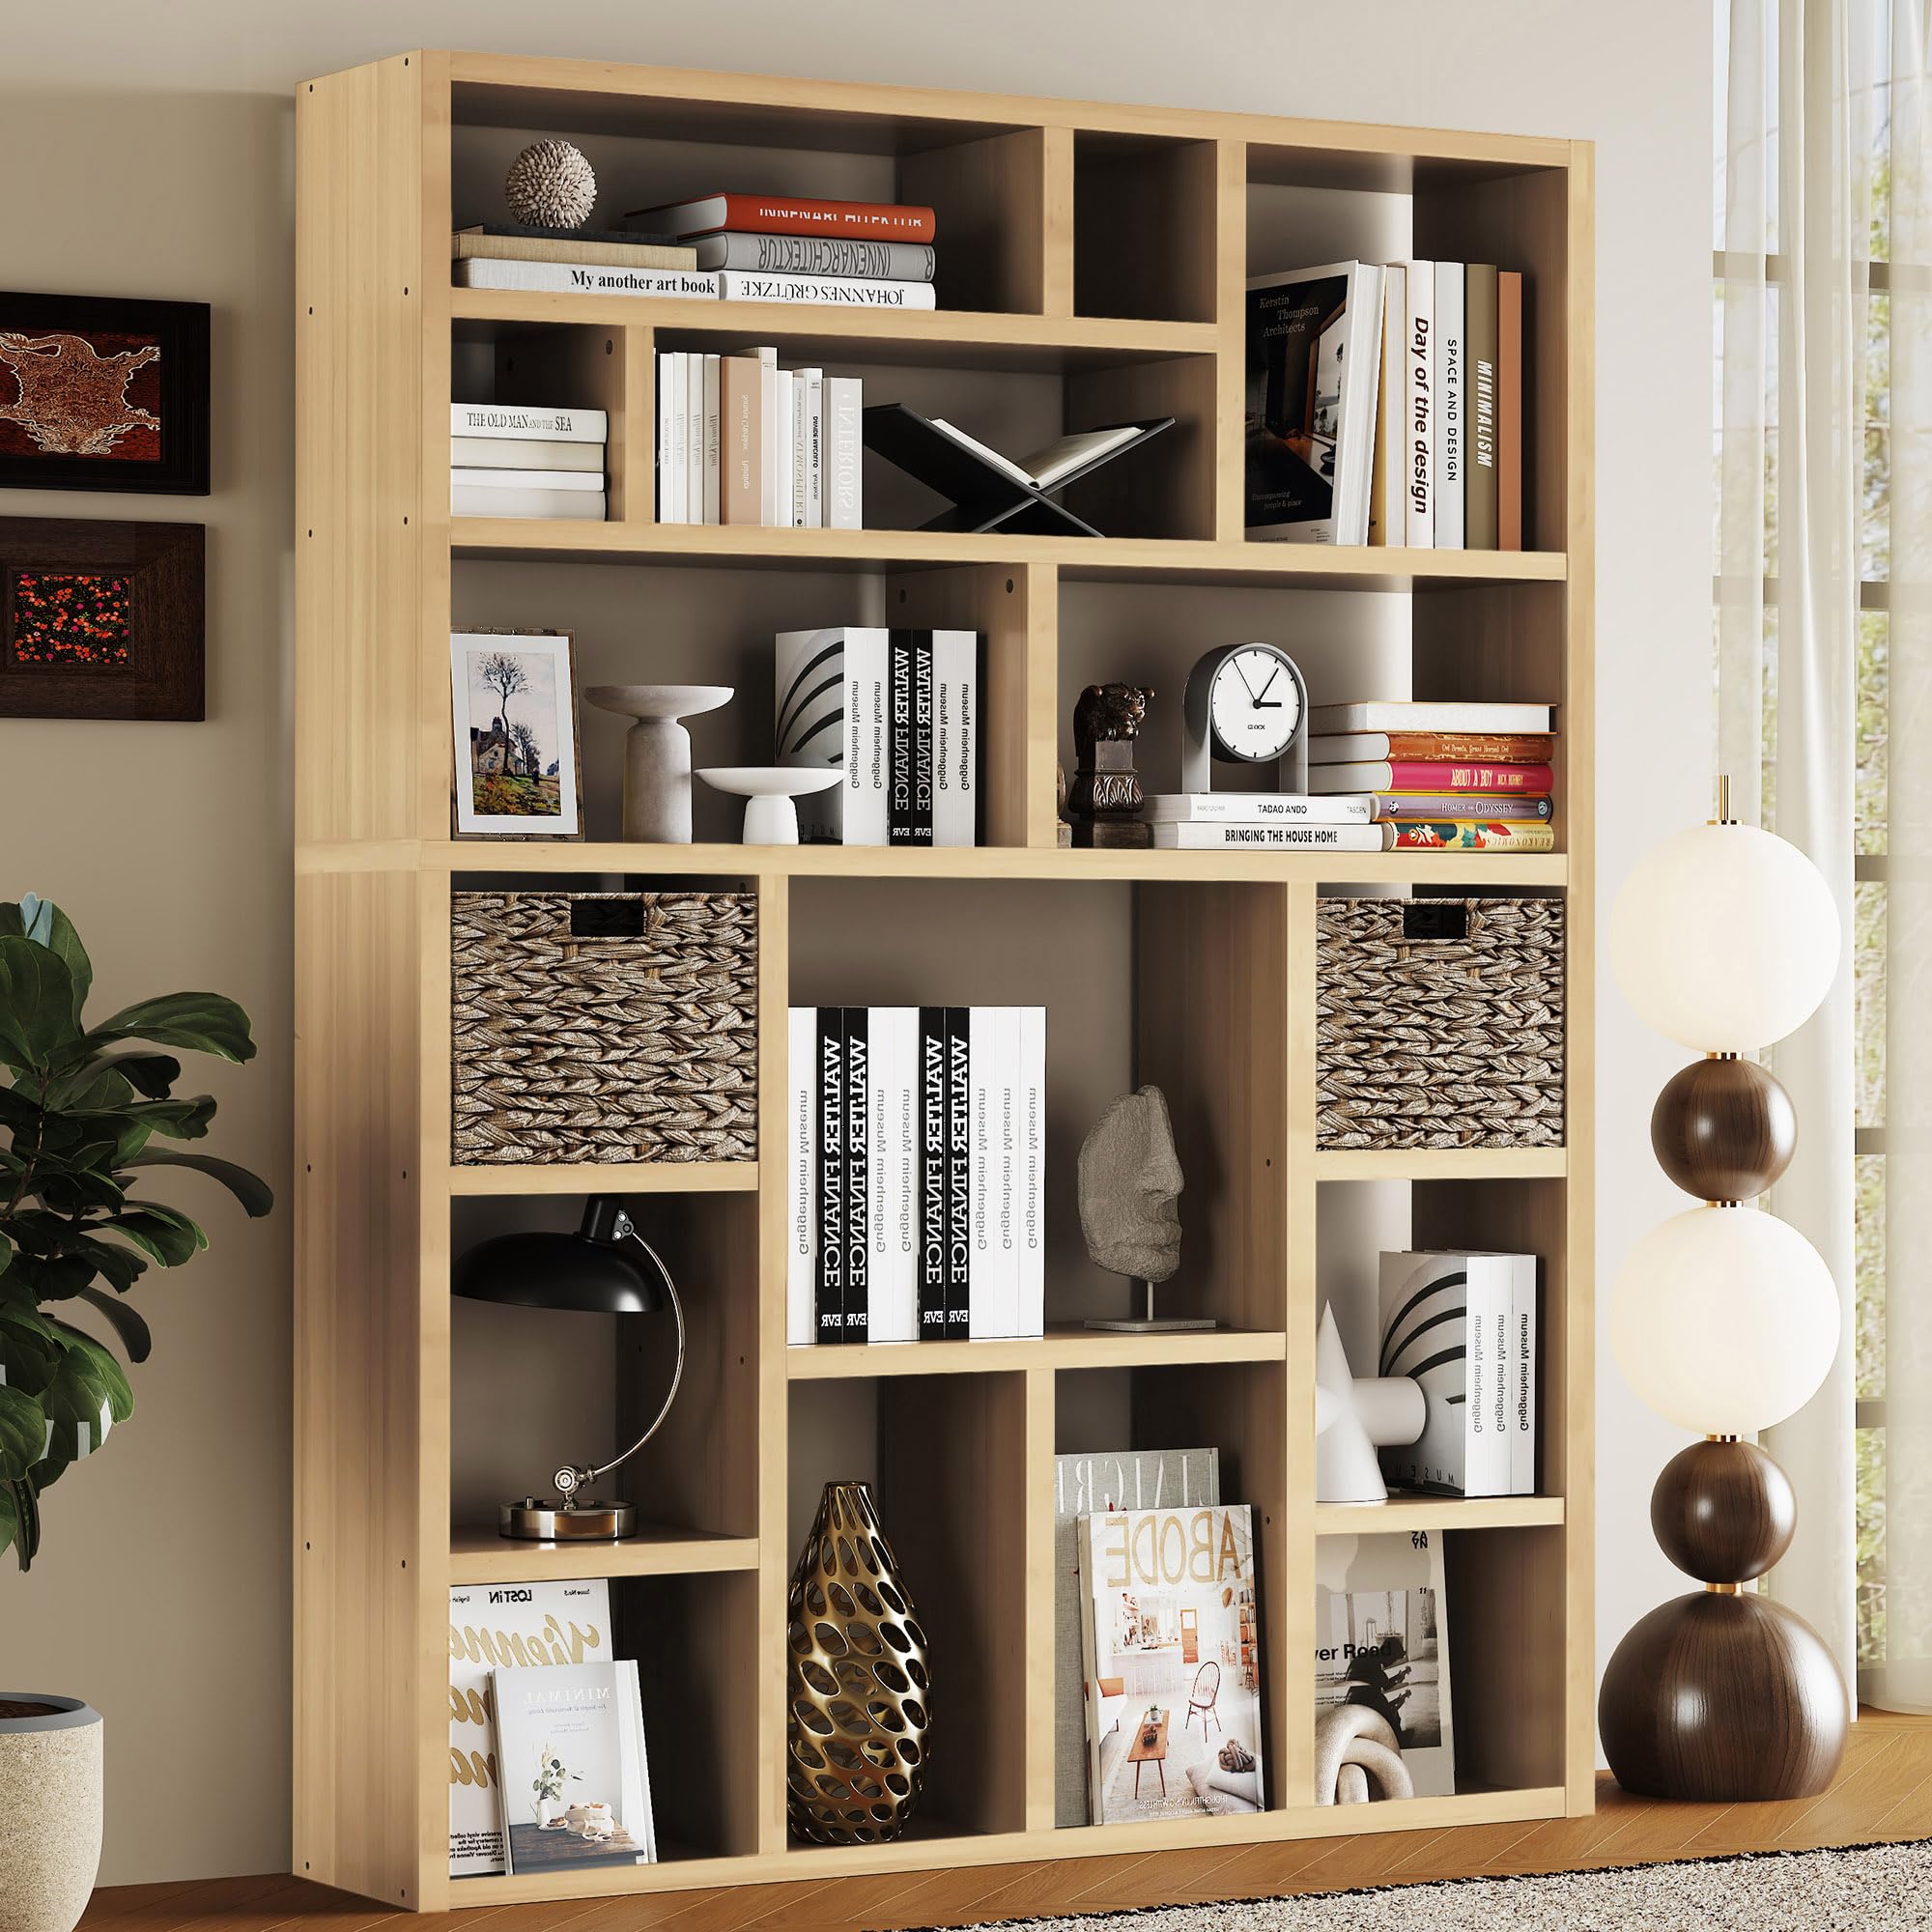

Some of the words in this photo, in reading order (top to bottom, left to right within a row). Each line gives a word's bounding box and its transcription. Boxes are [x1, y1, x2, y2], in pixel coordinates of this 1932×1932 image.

[758, 238, 891, 276] INNENARCHITEKTUR
[572, 270, 594, 290] My
[598, 273, 653, 290] another
[657, 278, 678, 291] art
[681, 277, 716, 294] book
[741, 280, 818, 300] GRÜTZKE
[821, 285, 904, 305] JOHANNES
[1260, 295, 1290, 309] Kerstin
[1277, 306, 1319, 321] Thompson
[1263, 323, 1306, 337] Architects
[1411, 317, 1429, 360] Day
[1448, 339, 1457, 384] SPACE
[1415, 367, 1429, 392] of
[1414, 396, 1429, 433] the
[1448, 390, 1457, 420] AND
[1478, 360, 1492, 468] MINIMALISM
[467, 412, 486, 427] THE
[487, 413, 507, 428] OLD
[508, 414, 529, 429] MAN
[554, 416, 572, 431] SEA
[1448, 428, 1457, 481] DESIGN
[1411, 440, 1429, 514] design
[1451, 769, 1470, 786] ABOUT
[1472, 770, 1479, 786] A
[1480, 770, 1493, 787] BOY
[1258, 805, 1284, 813] TADAO
[1285, 805, 1307, 814] ANDO
[1441, 804, 1466, 812] HOMER
[1475, 802, 1514, 814] ODYSSEY
[1225, 830, 1265, 842] BRINGING
[1267, 830, 1283, 842] THE
[1285, 831, 1312, 842] HOUSE
[1315, 831, 1338, 842] HOME
